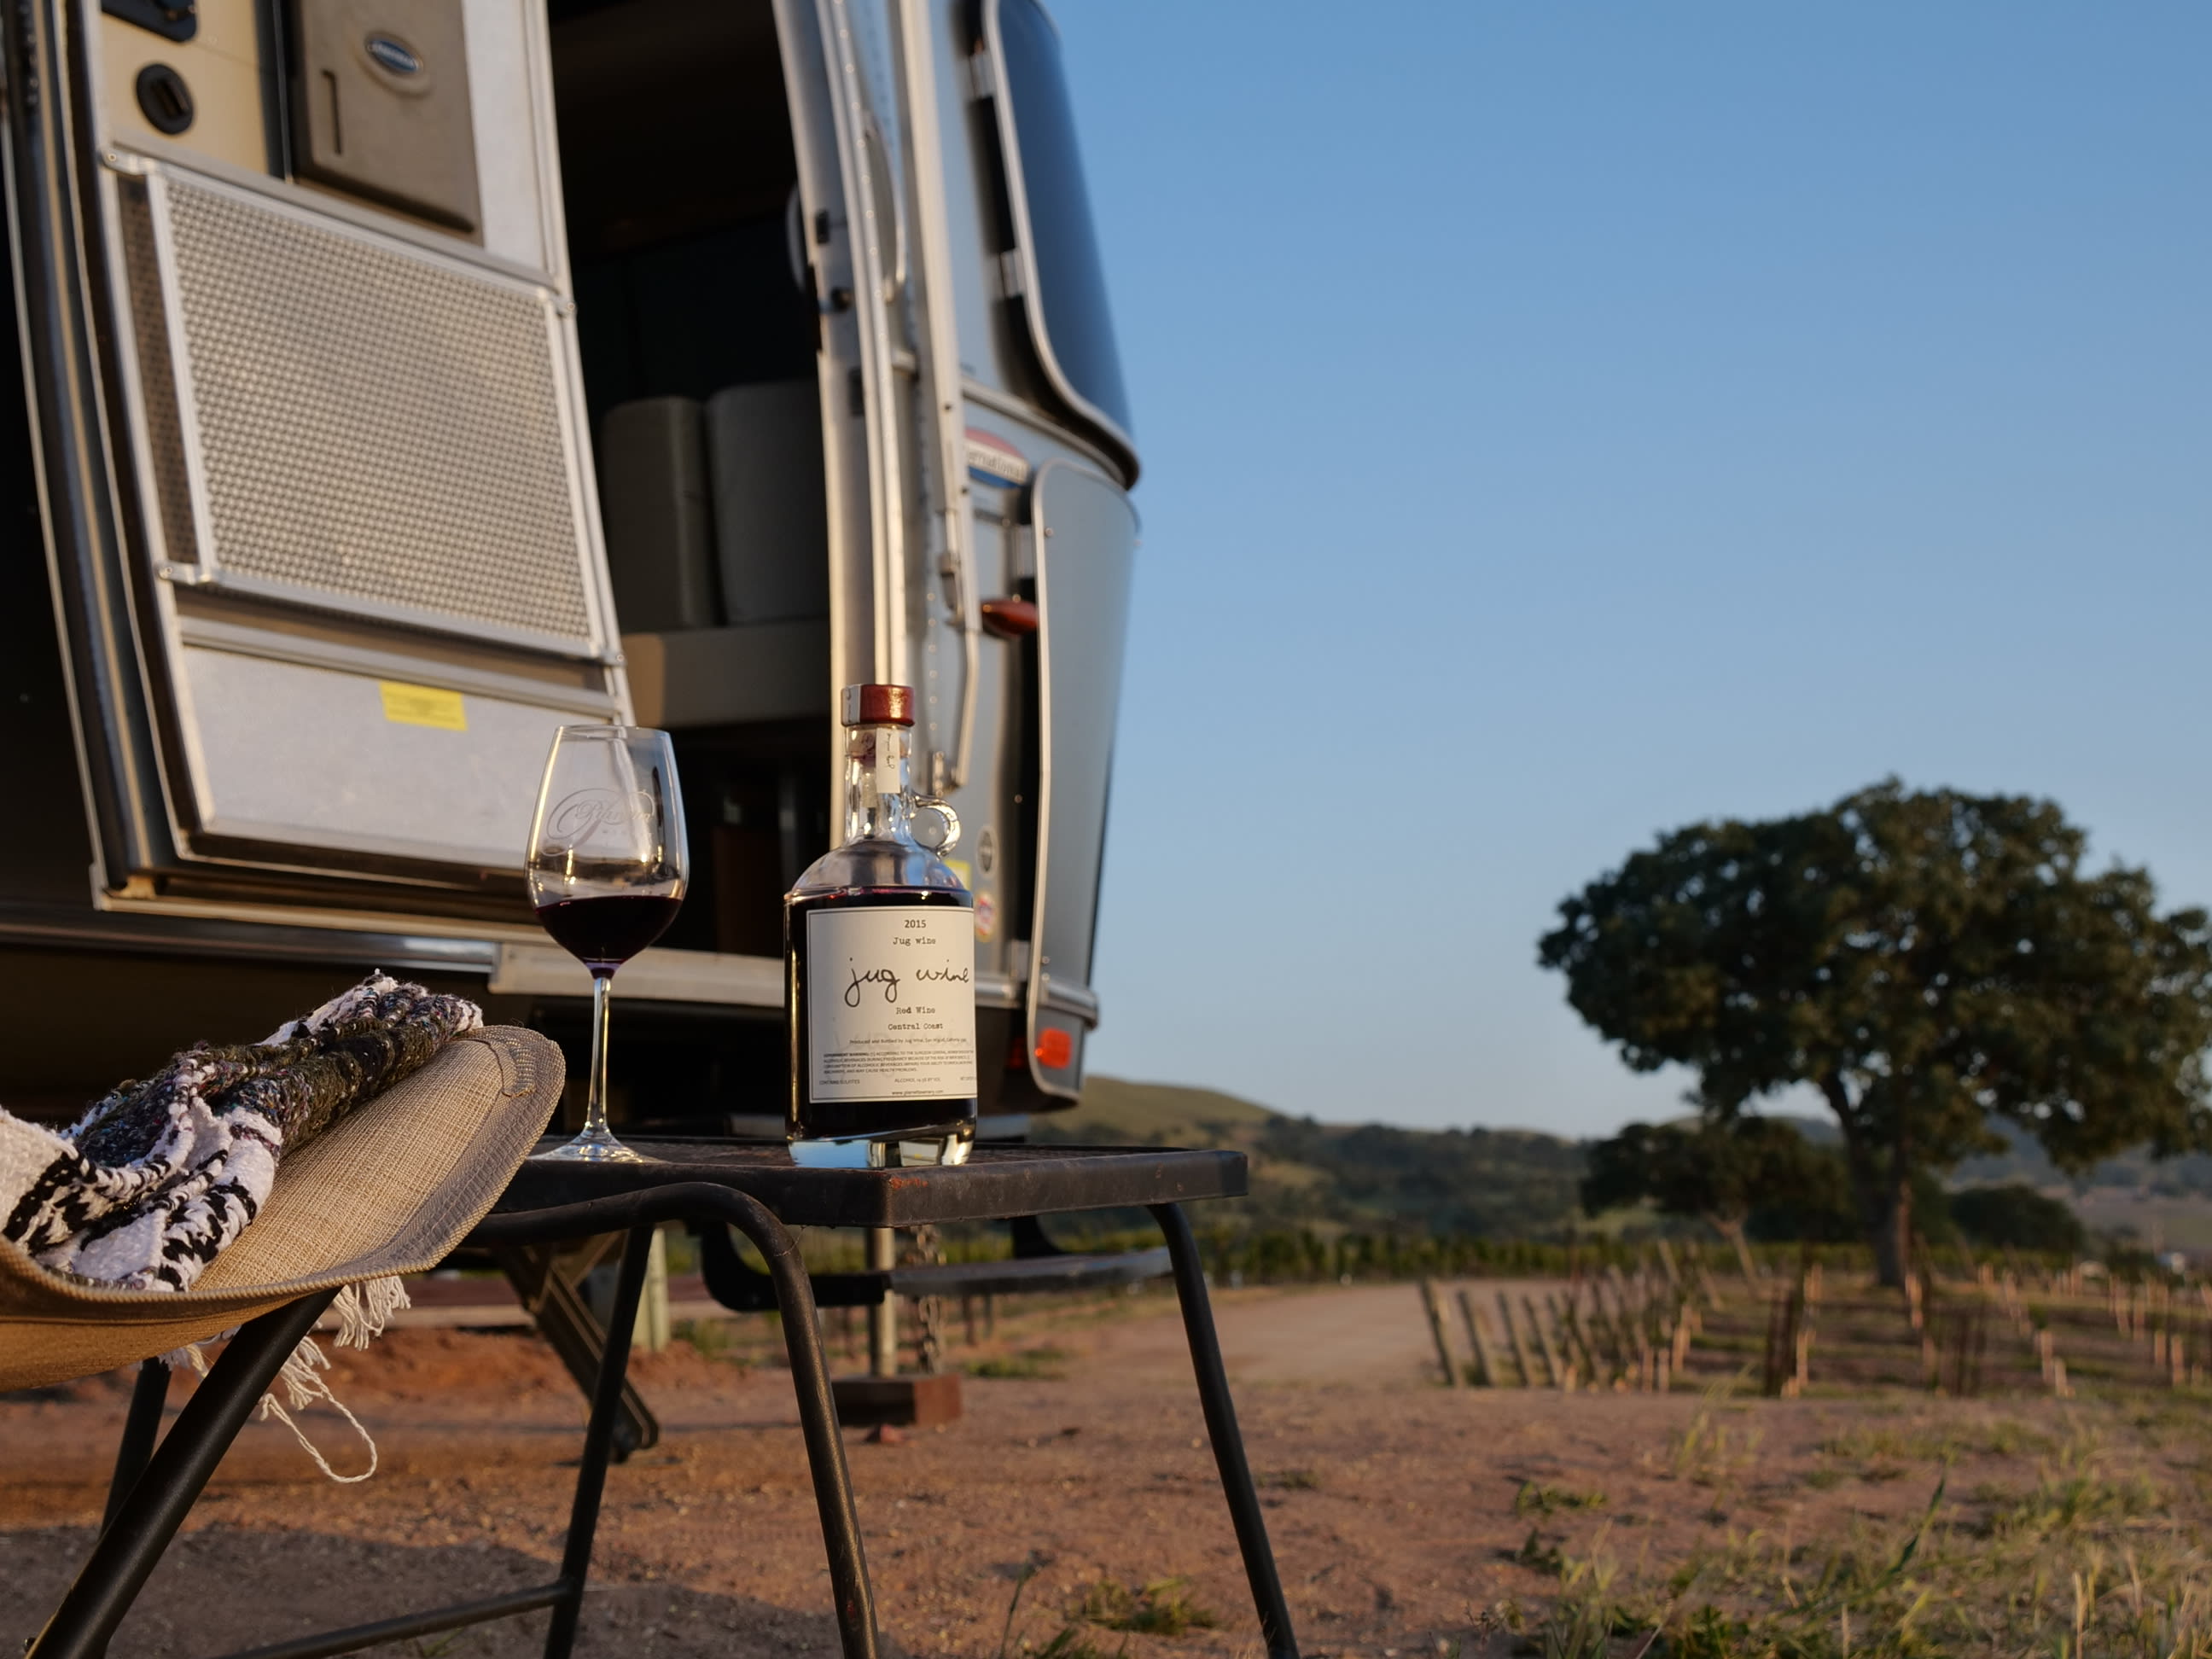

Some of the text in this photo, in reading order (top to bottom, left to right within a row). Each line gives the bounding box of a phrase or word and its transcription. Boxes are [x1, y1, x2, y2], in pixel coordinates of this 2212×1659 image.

[904, 919, 927, 928] 2015
[893, 937, 911, 946] Jug
[845, 957, 969, 1007] jug wine
